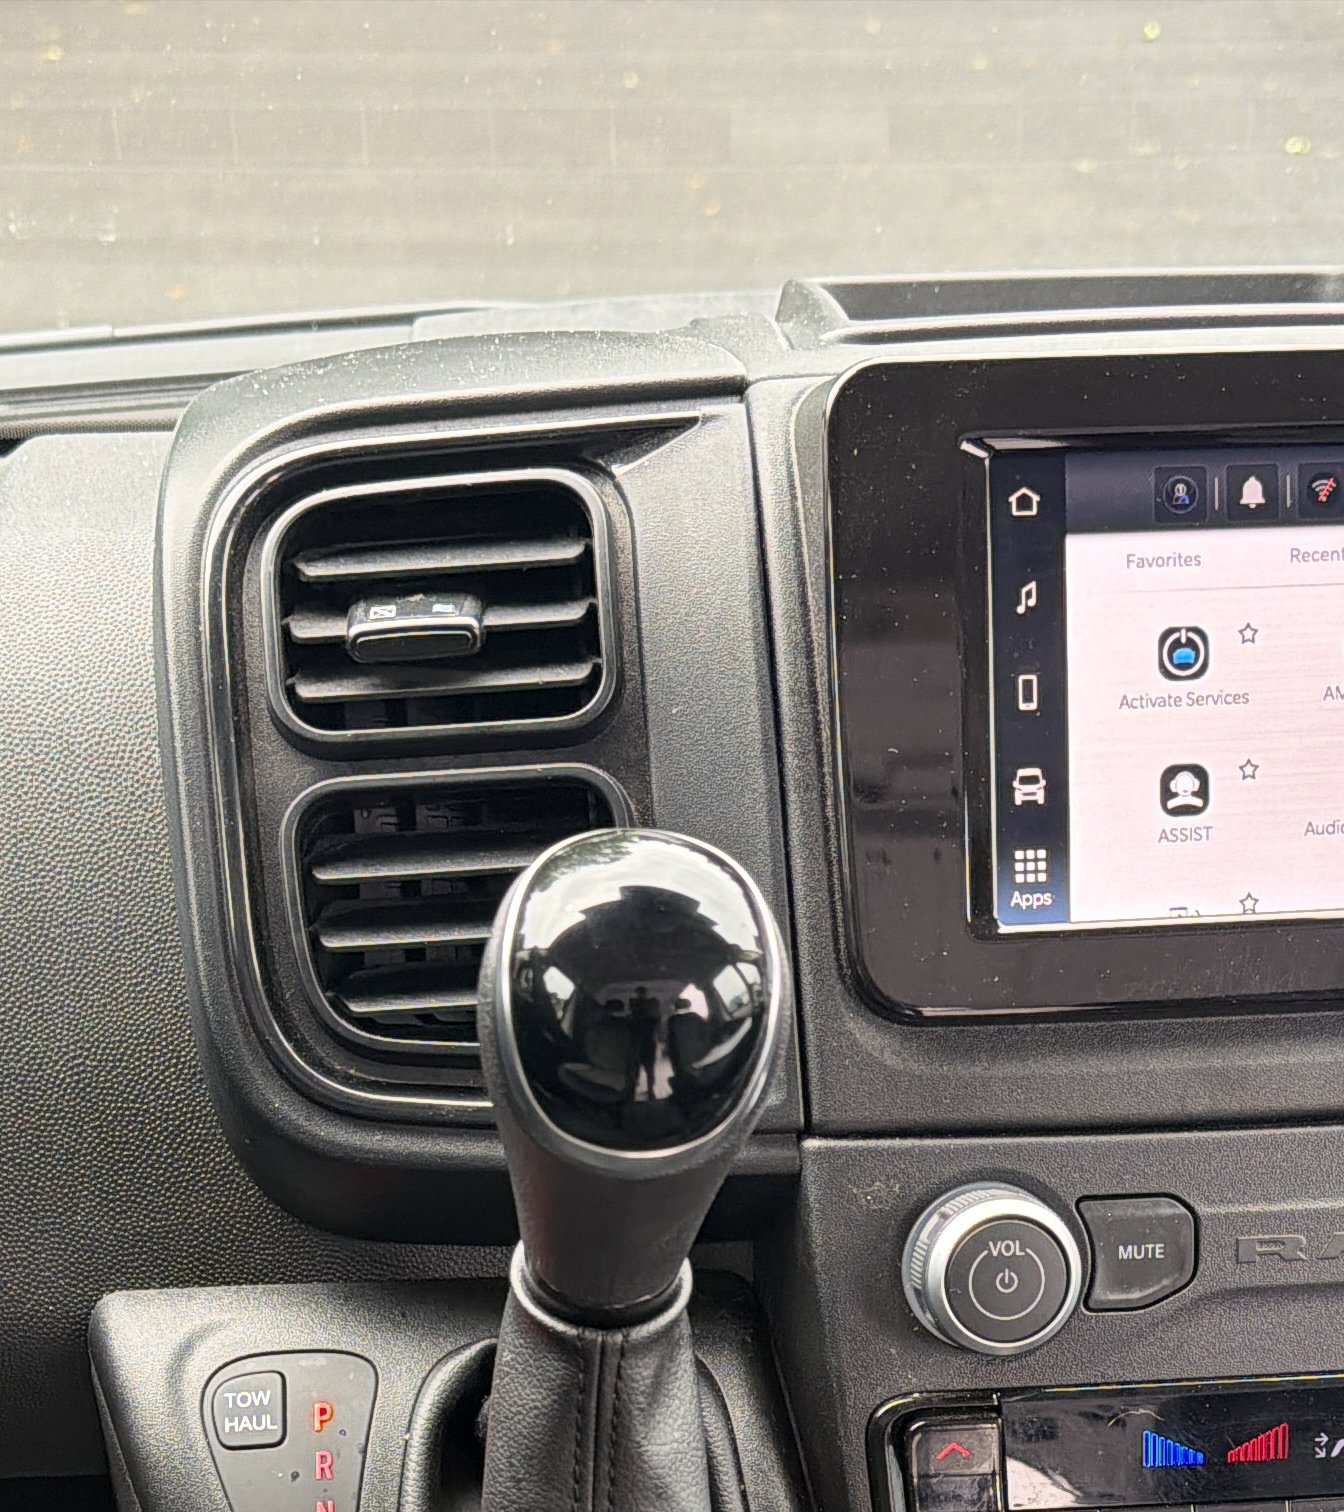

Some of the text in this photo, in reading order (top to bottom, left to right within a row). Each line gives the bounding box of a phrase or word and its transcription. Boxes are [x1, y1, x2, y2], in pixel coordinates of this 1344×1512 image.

[1126, 552, 1202, 570] Favorites
[1118, 689, 1250, 710] Activate Services
[1158, 826, 1212, 844] ASSIST
[1010, 891, 1053, 909] Apps
[989, 1240, 1025, 1257] VOL
[1118, 1243, 1165, 1260] MUTE
[224, 1391, 271, 1409] TOW
[224, 1414, 278, 1433] HAUL
[313, 1402, 333, 1431] P
[315, 1450, 334, 1480] R
